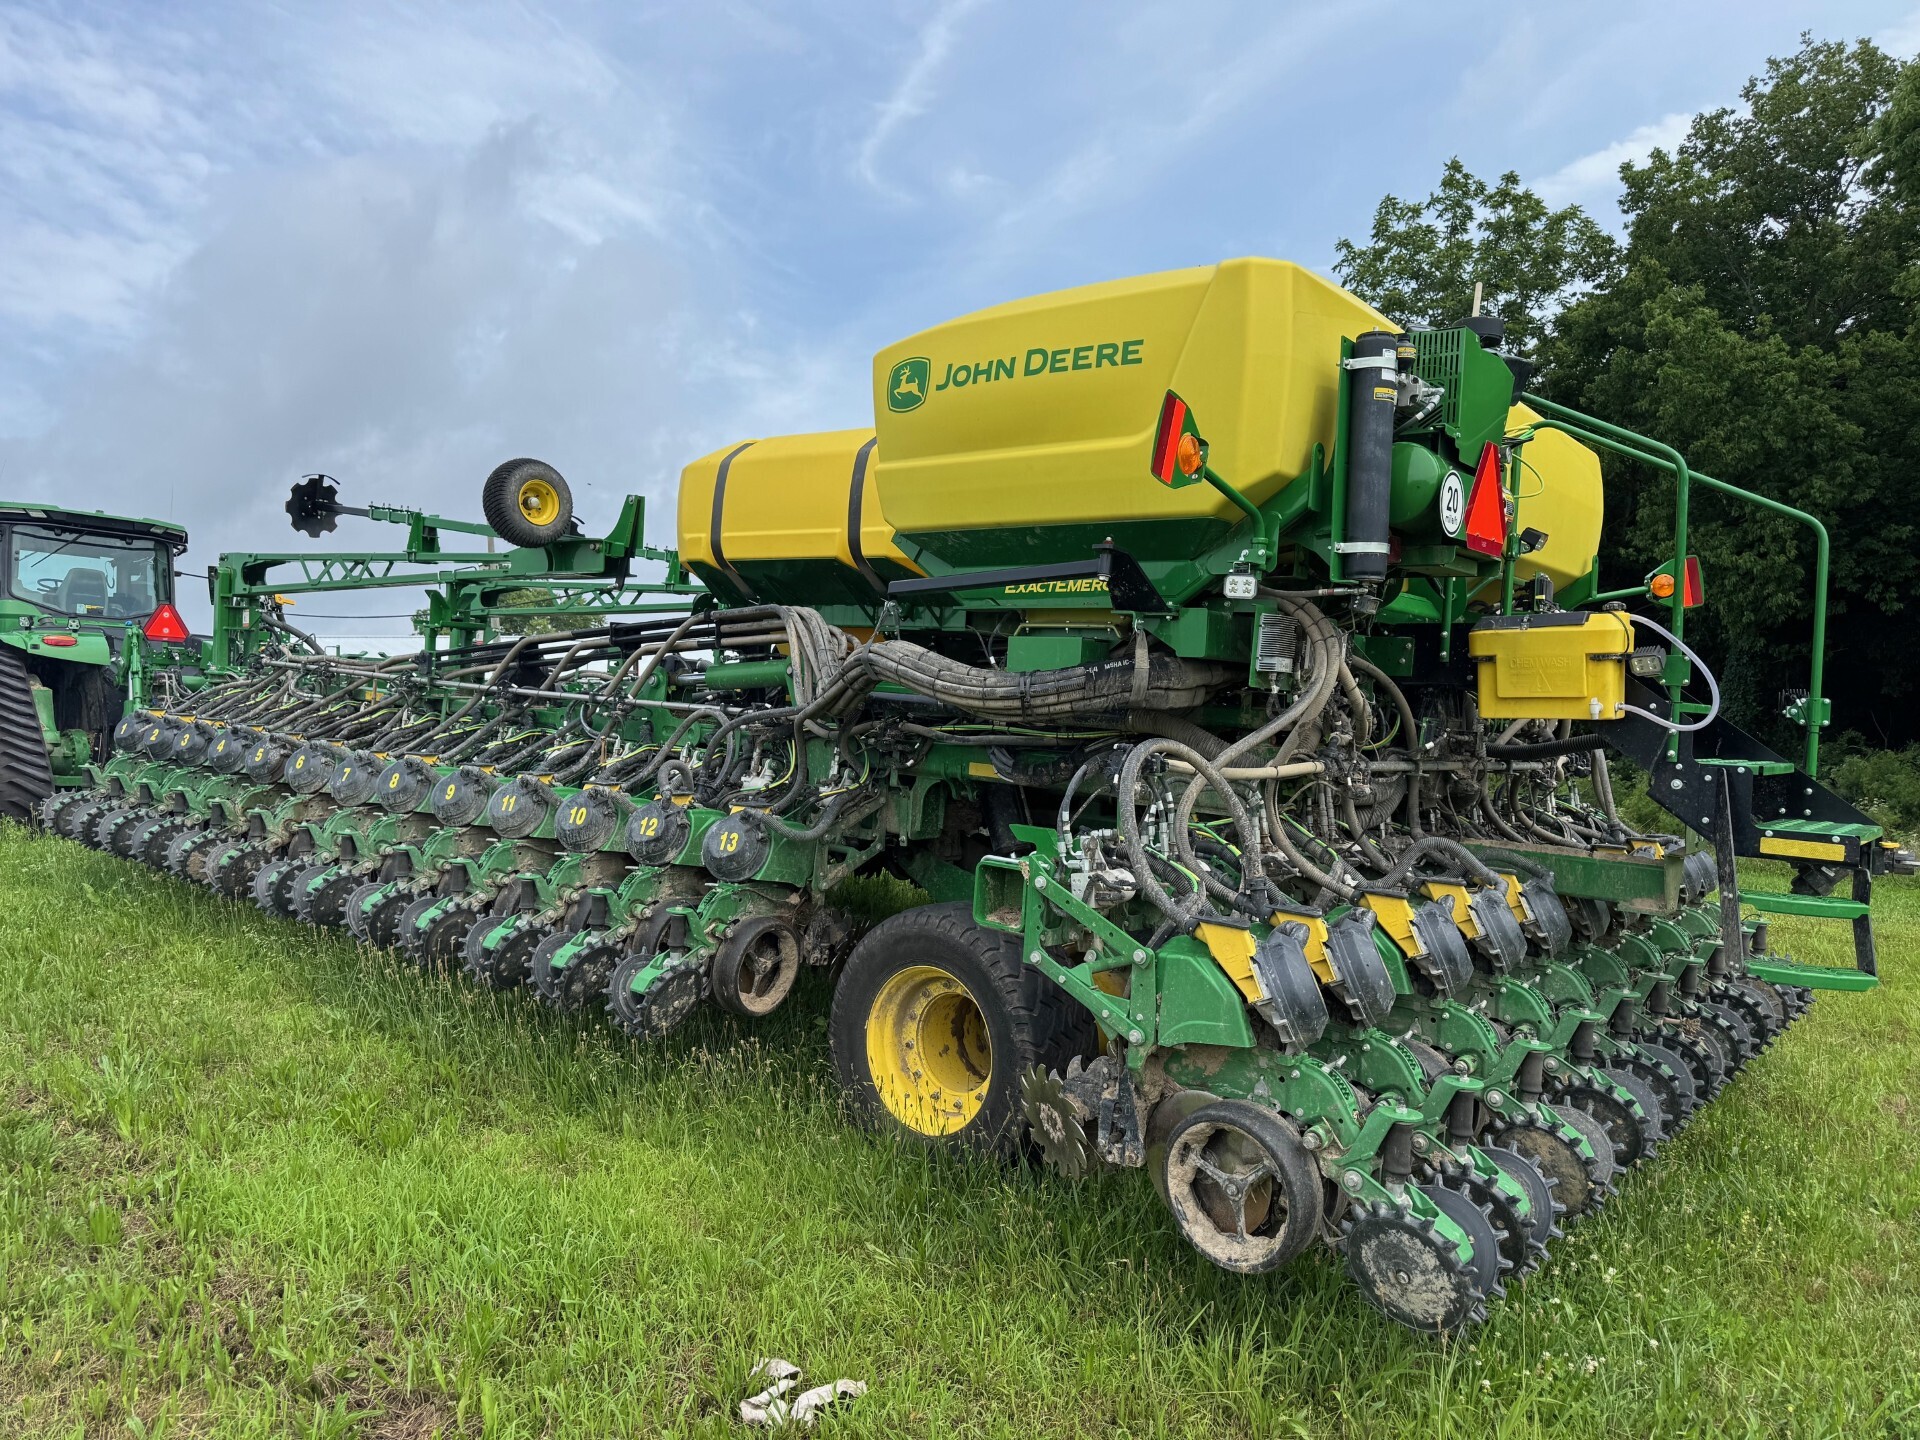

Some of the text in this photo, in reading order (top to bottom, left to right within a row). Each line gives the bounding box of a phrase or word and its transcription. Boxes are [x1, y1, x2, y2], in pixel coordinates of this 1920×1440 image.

[936, 339, 1144, 391] JOHN DEERE
[1446, 485, 1459, 514] 20
[120, 722, 128, 735] 1
[149, 728, 160, 741] 2
[181, 733, 190, 747] 3
[216, 739, 226, 753] 4
[254, 748, 264, 762] 5
[295, 755, 306, 769] 6
[341, 767, 351, 782] 7
[388, 772, 400, 789] 8
[445, 783, 456, 800] 9
[502, 795, 517, 812] 11
[569, 806, 587, 825] 10
[640, 816, 659, 837] 12
[719, 831, 740, 852] 13
